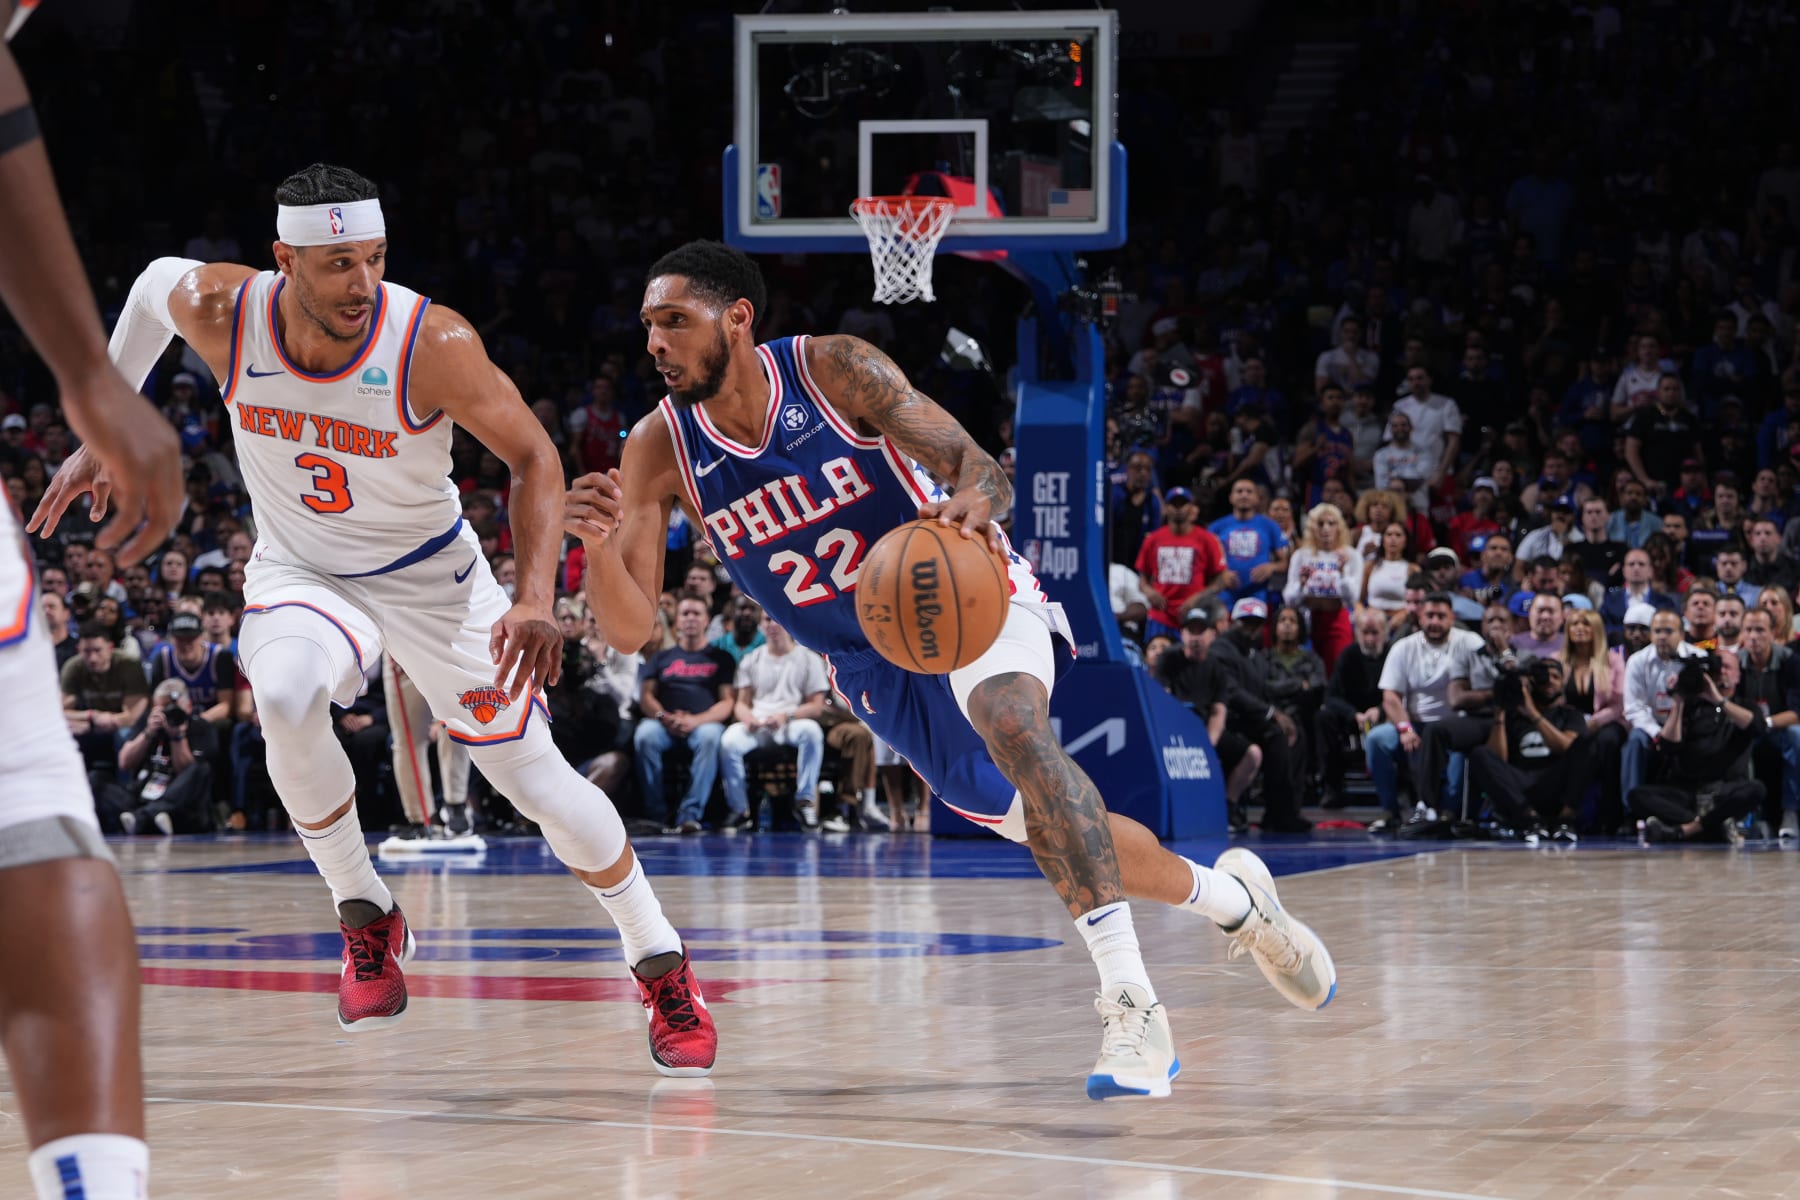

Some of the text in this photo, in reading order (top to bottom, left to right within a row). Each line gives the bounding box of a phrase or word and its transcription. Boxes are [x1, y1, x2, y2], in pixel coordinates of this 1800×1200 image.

[357, 386, 391, 397] sphere
[236, 401, 398, 458] NEW YORK
[786, 420, 828, 451] crypto.com
[294, 451, 354, 513] 3
[1032, 471, 1071, 505] GET
[704, 457, 875, 559] PHILA
[1032, 505, 1071, 538] THE
[768, 528, 867, 607] 22
[1041, 540, 1079, 580] App
[911, 557, 943, 660] Wilson
[459, 688, 511, 706] KNICKS
